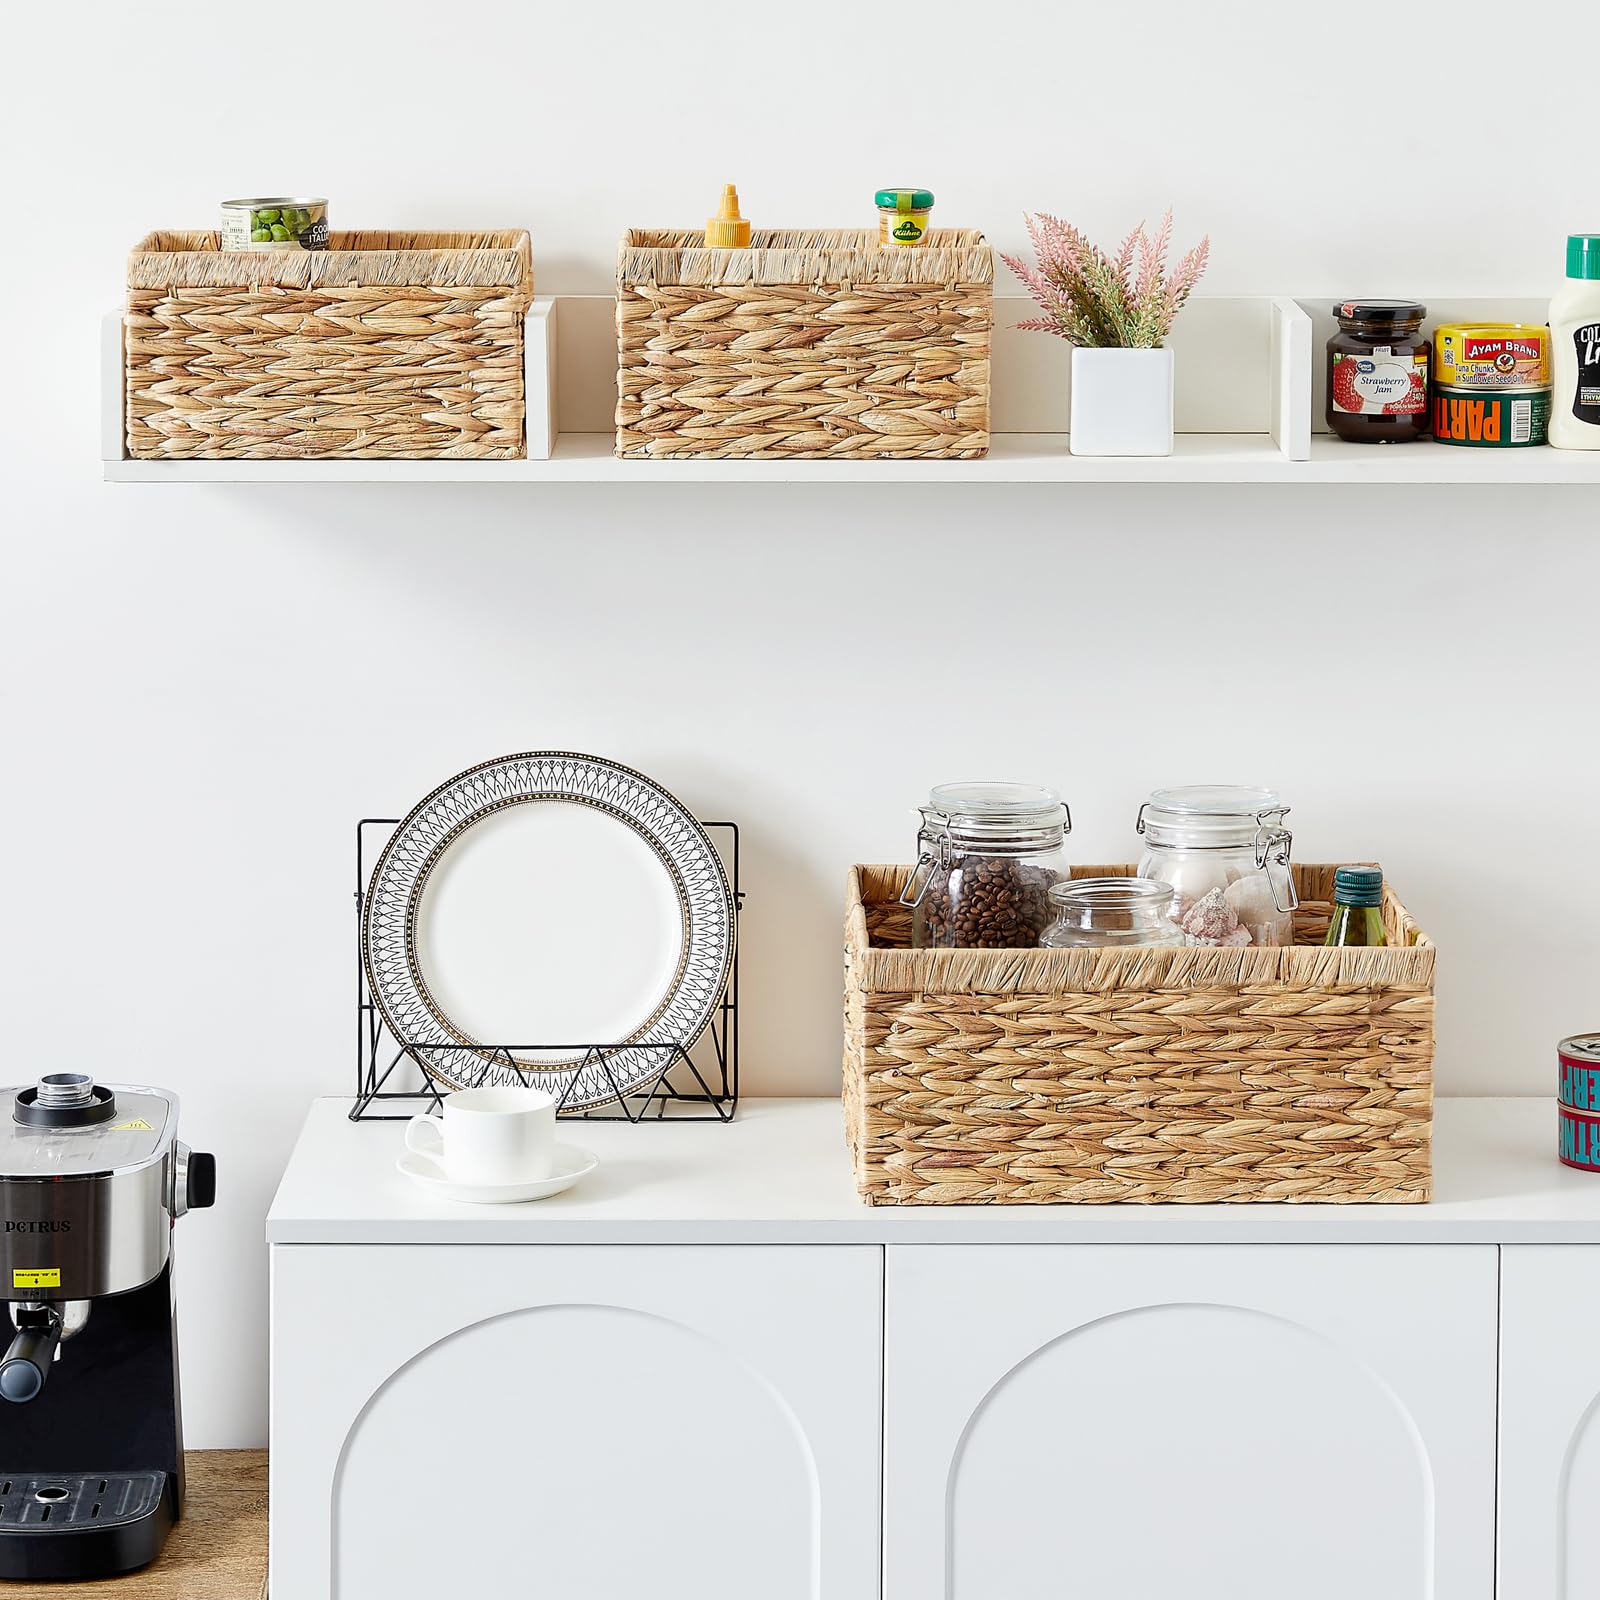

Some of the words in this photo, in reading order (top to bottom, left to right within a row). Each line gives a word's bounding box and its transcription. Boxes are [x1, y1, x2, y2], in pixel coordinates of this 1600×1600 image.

[1469, 343, 1502, 359] AYAM
[1505, 341, 1538, 359] BRAND
[1455, 363, 1469, 373] Tuna
[1470, 363, 1495, 373] Chunks
[1361, 376, 1406, 387] Strawberry
[1455, 373, 1461, 382] in
[1462, 373, 1494, 383] Sunflower
[1495, 374, 1511, 383] Seed
[1375, 386, 1392, 394] Jam
[5, 1220, 71, 1233] PETRUS
